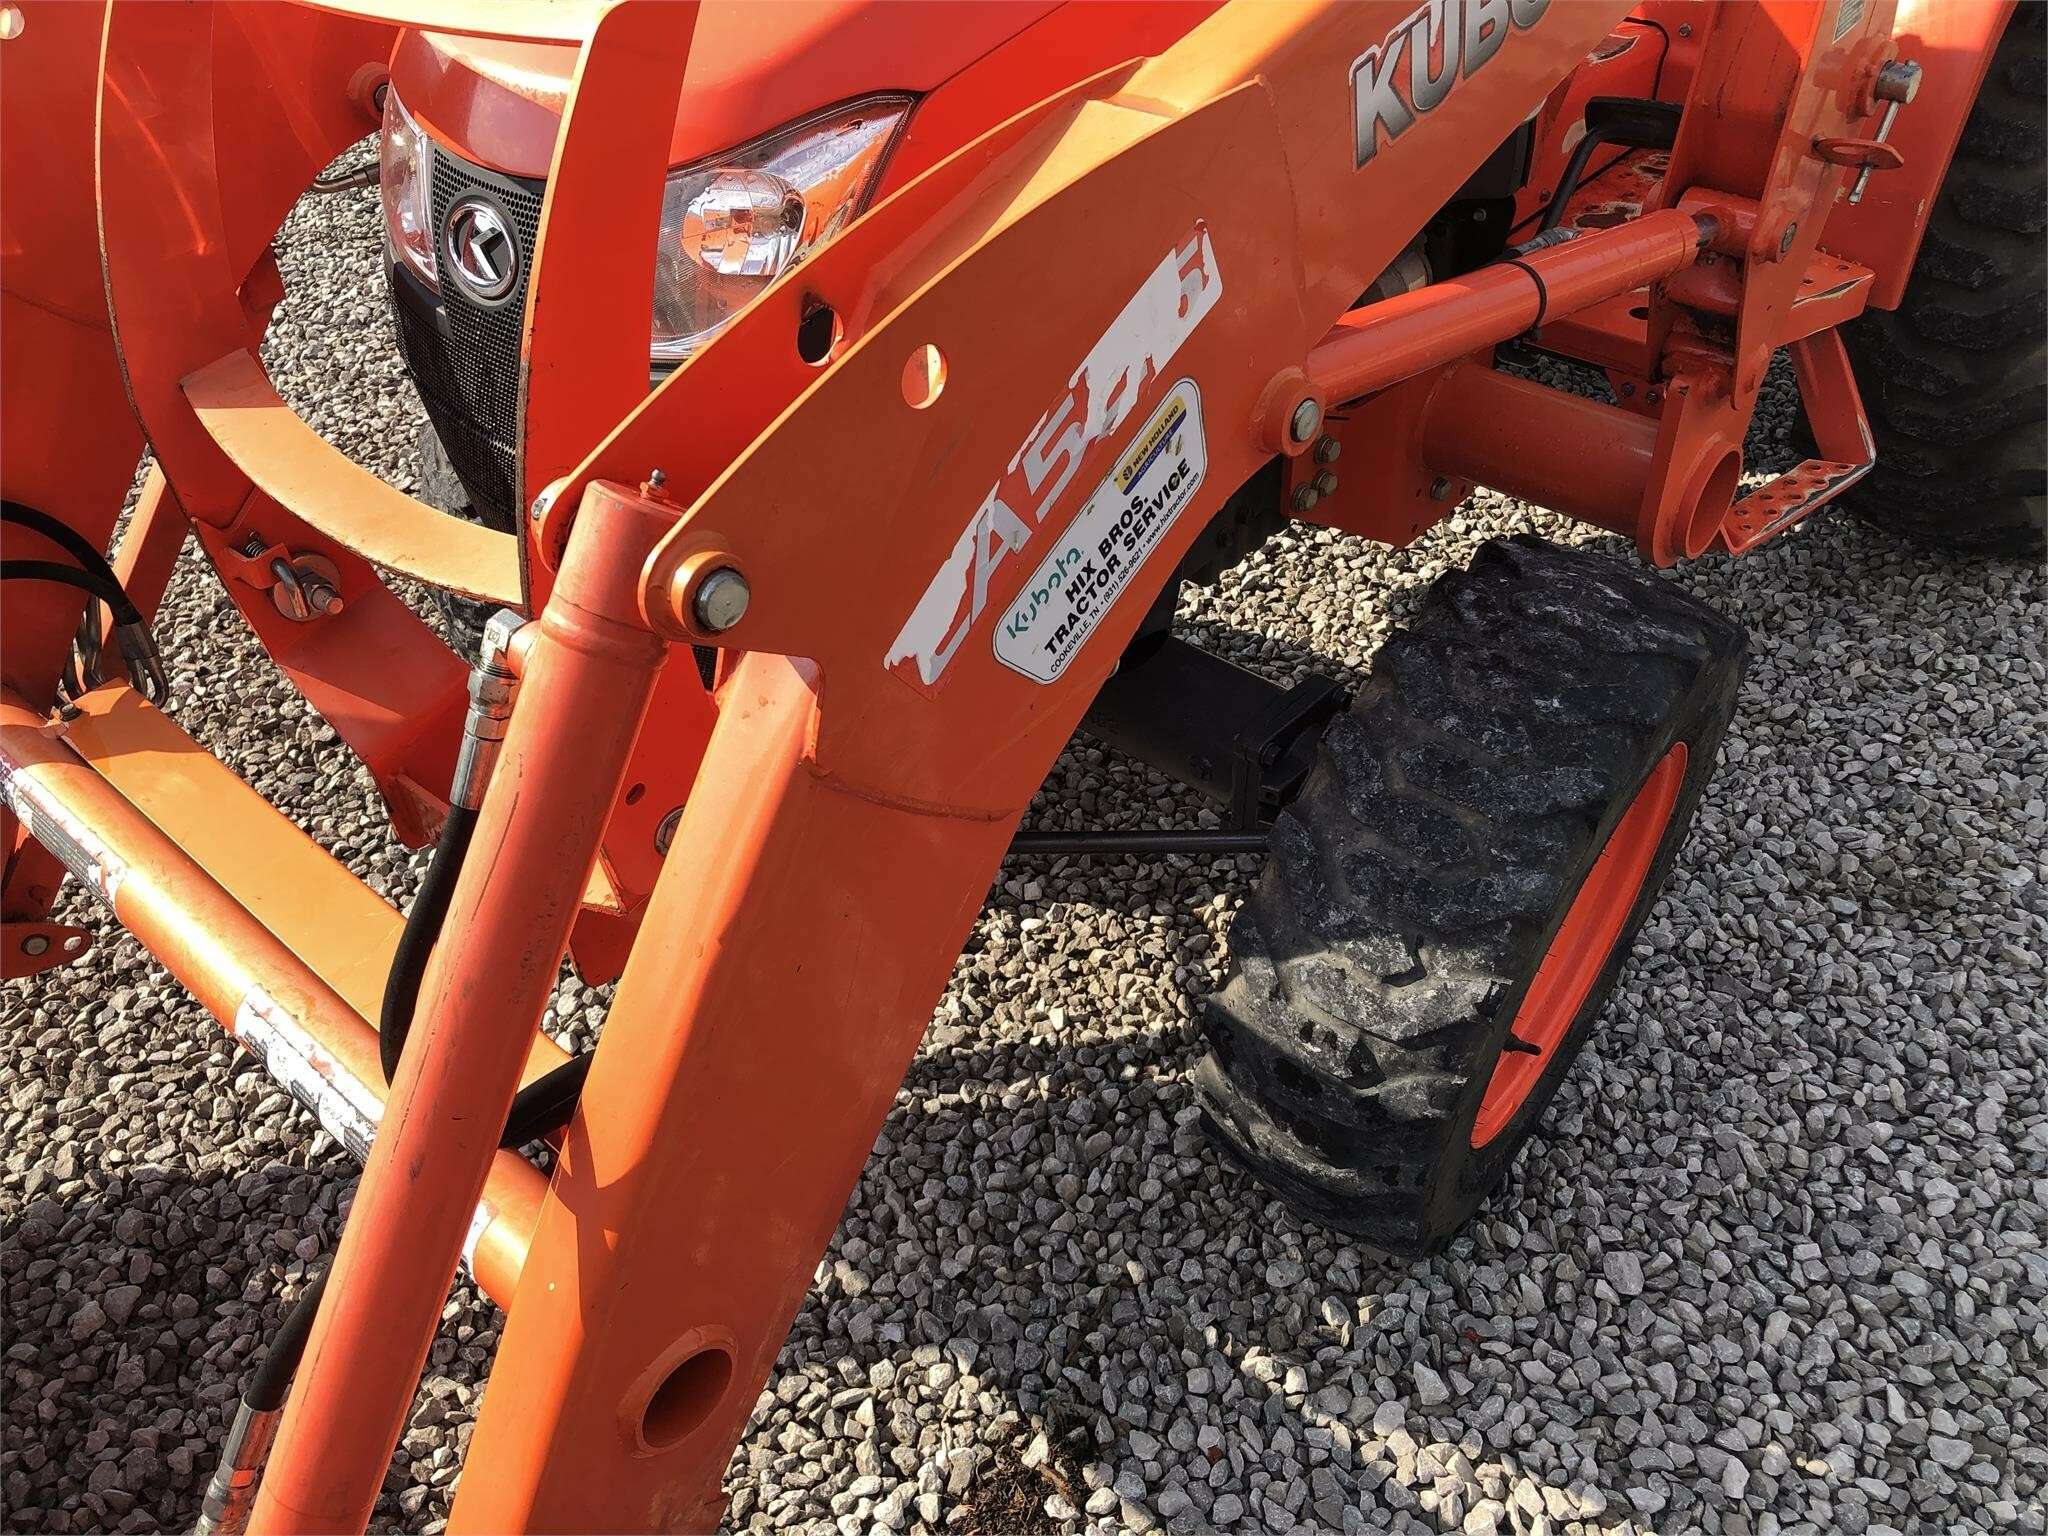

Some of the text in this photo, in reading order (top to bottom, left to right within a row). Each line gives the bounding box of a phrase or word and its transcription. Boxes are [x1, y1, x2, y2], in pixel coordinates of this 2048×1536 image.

[1352, 0, 1551, 169] KUB
[1133, 405, 1178, 468] NEW HOLLAND
[1134, 429, 1177, 478] AGRICULTURE
[1006, 548, 1084, 639] Kubota
[1044, 458, 1190, 654] TRACTOR SERVICE
[1051, 472, 1200, 672] COOKEVILLE, TN (931) 526-9621 www.hixtractor.com
[1065, 496, 1148, 604] HIX BROS.
